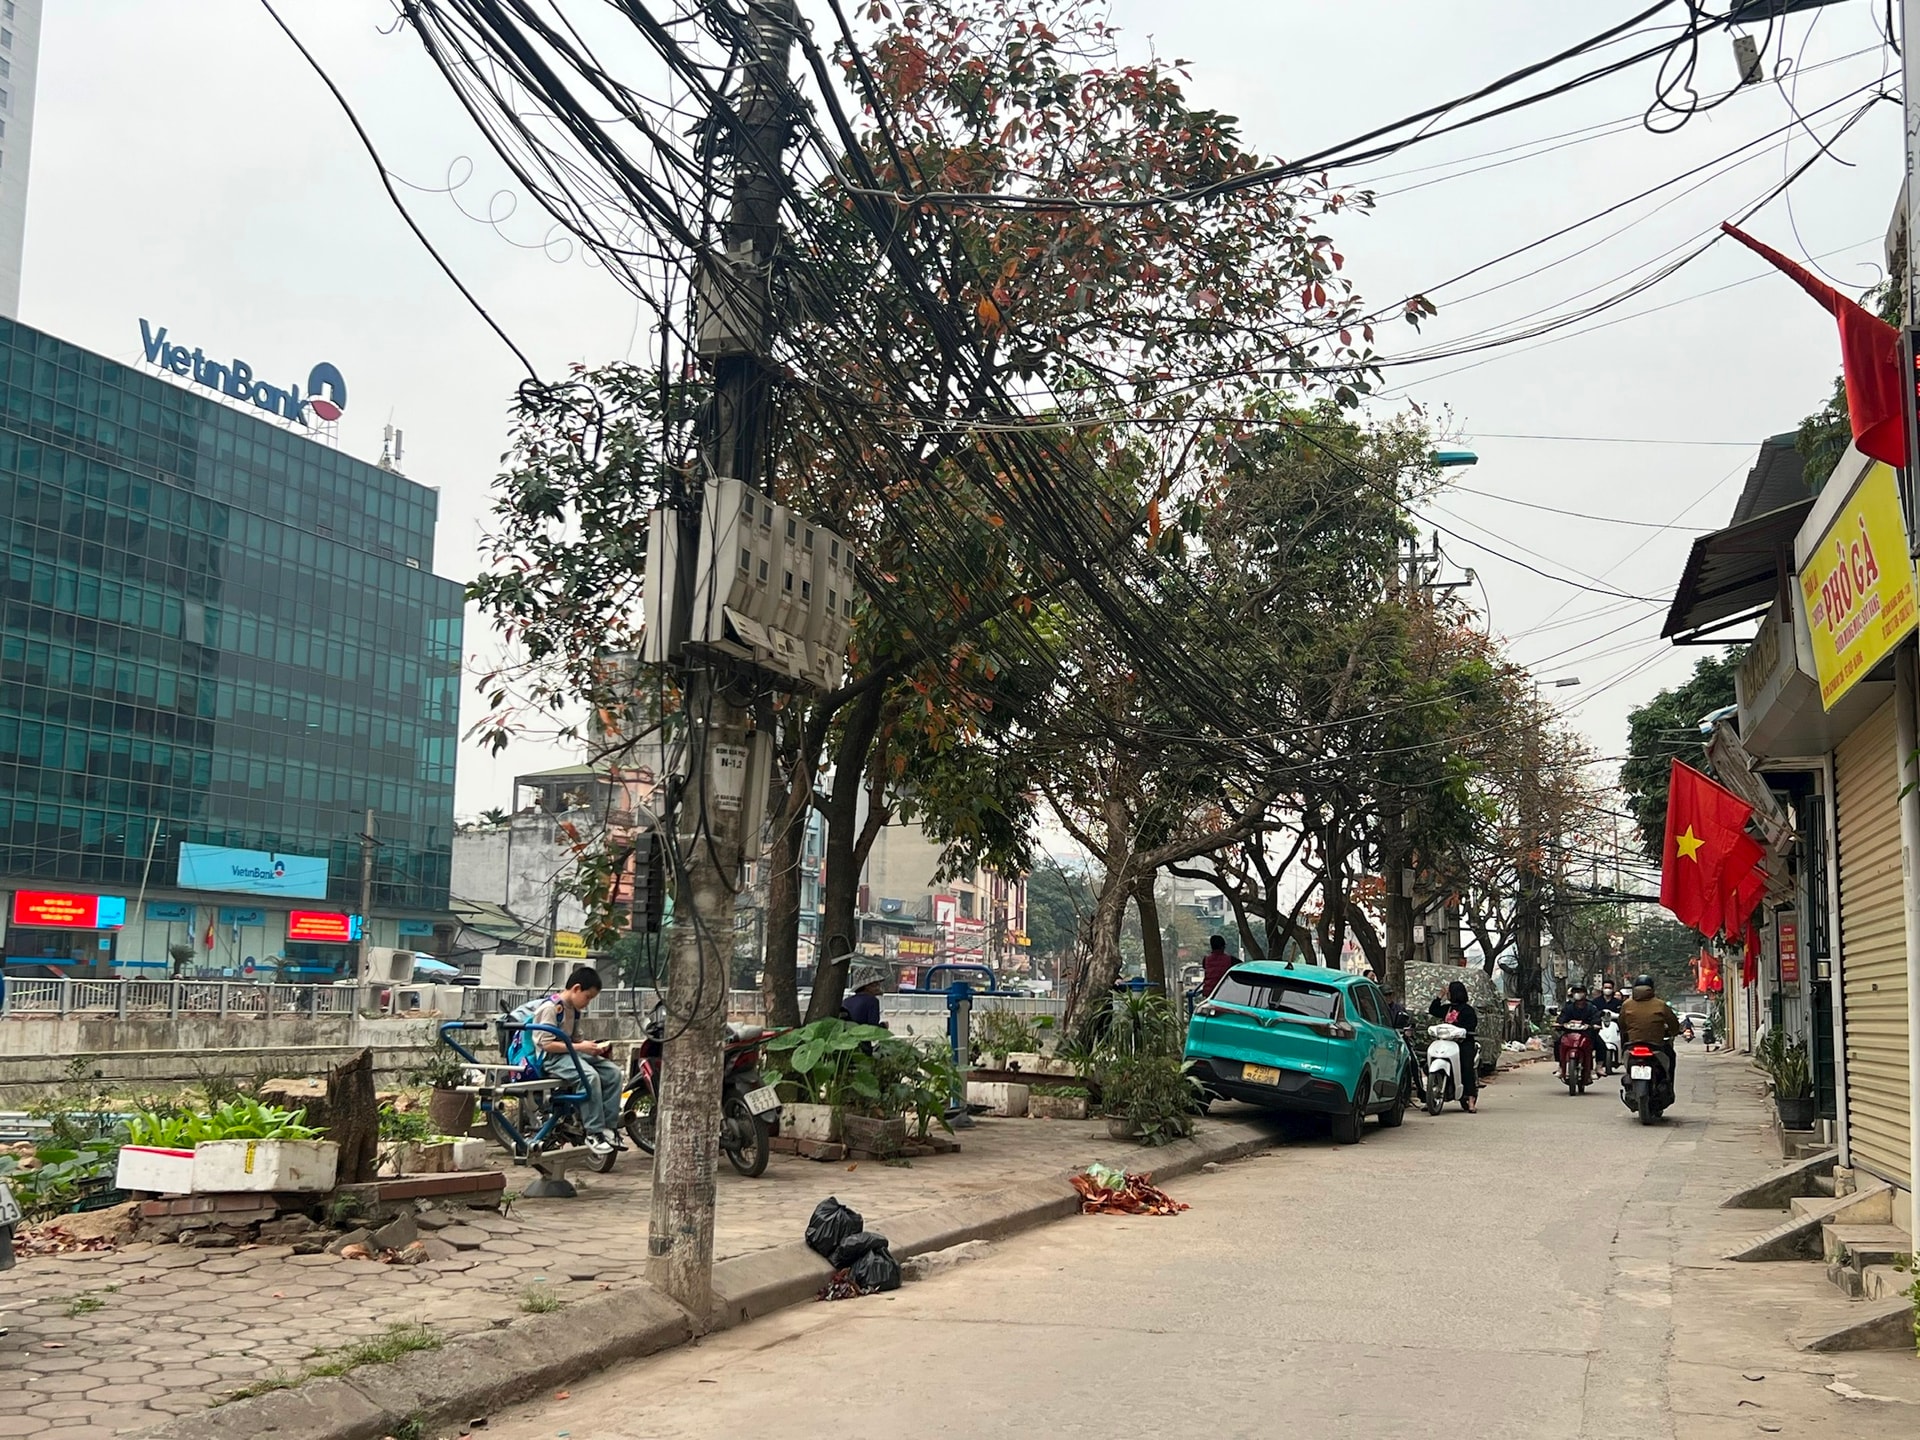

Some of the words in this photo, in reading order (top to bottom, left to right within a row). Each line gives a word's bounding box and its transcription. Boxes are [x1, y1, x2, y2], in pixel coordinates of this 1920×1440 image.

[139, 318, 311, 426] VietinBank
[1821, 541, 1852, 632] PHỞ
[1852, 516, 1879, 595] GÀ
[232, 865, 275, 879] VietinBank
